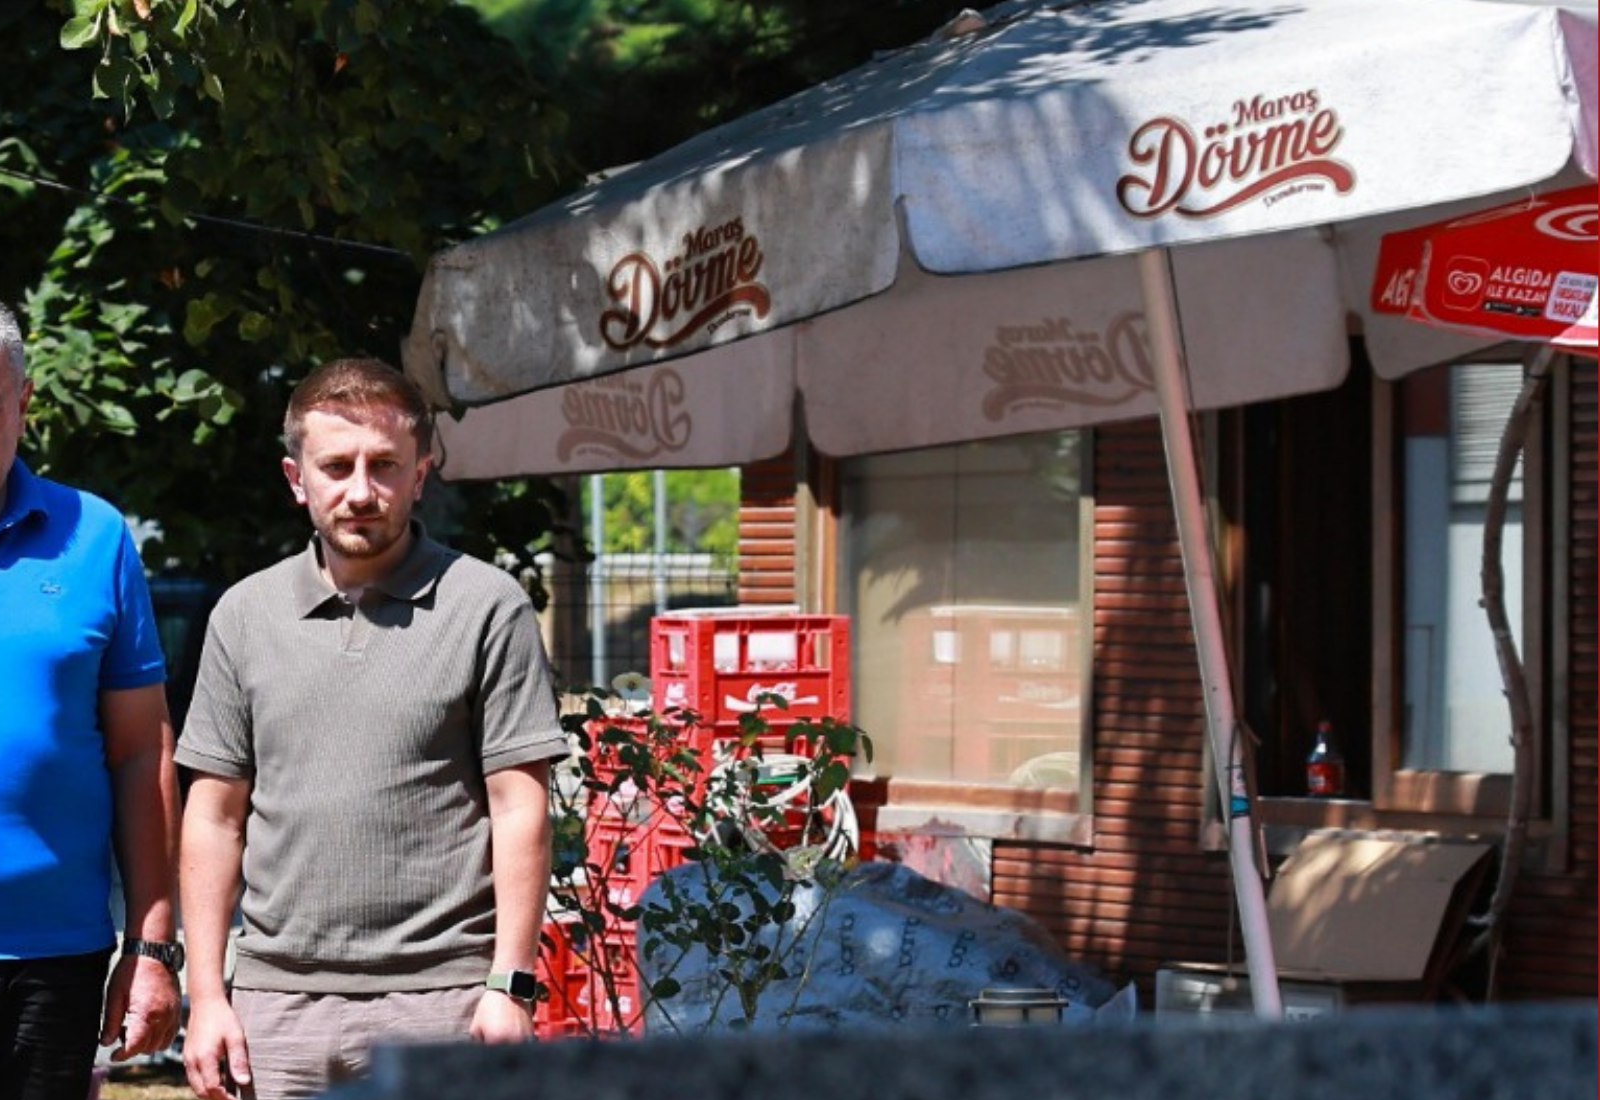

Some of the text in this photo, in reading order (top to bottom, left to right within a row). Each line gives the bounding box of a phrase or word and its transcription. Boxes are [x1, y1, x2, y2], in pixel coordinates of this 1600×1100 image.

[1232, 88, 1319, 128] Maraş
[1116, 109, 1344, 219] Dövme
[682, 215, 745, 258] Maraş
[601, 235, 763, 351] Dövme
